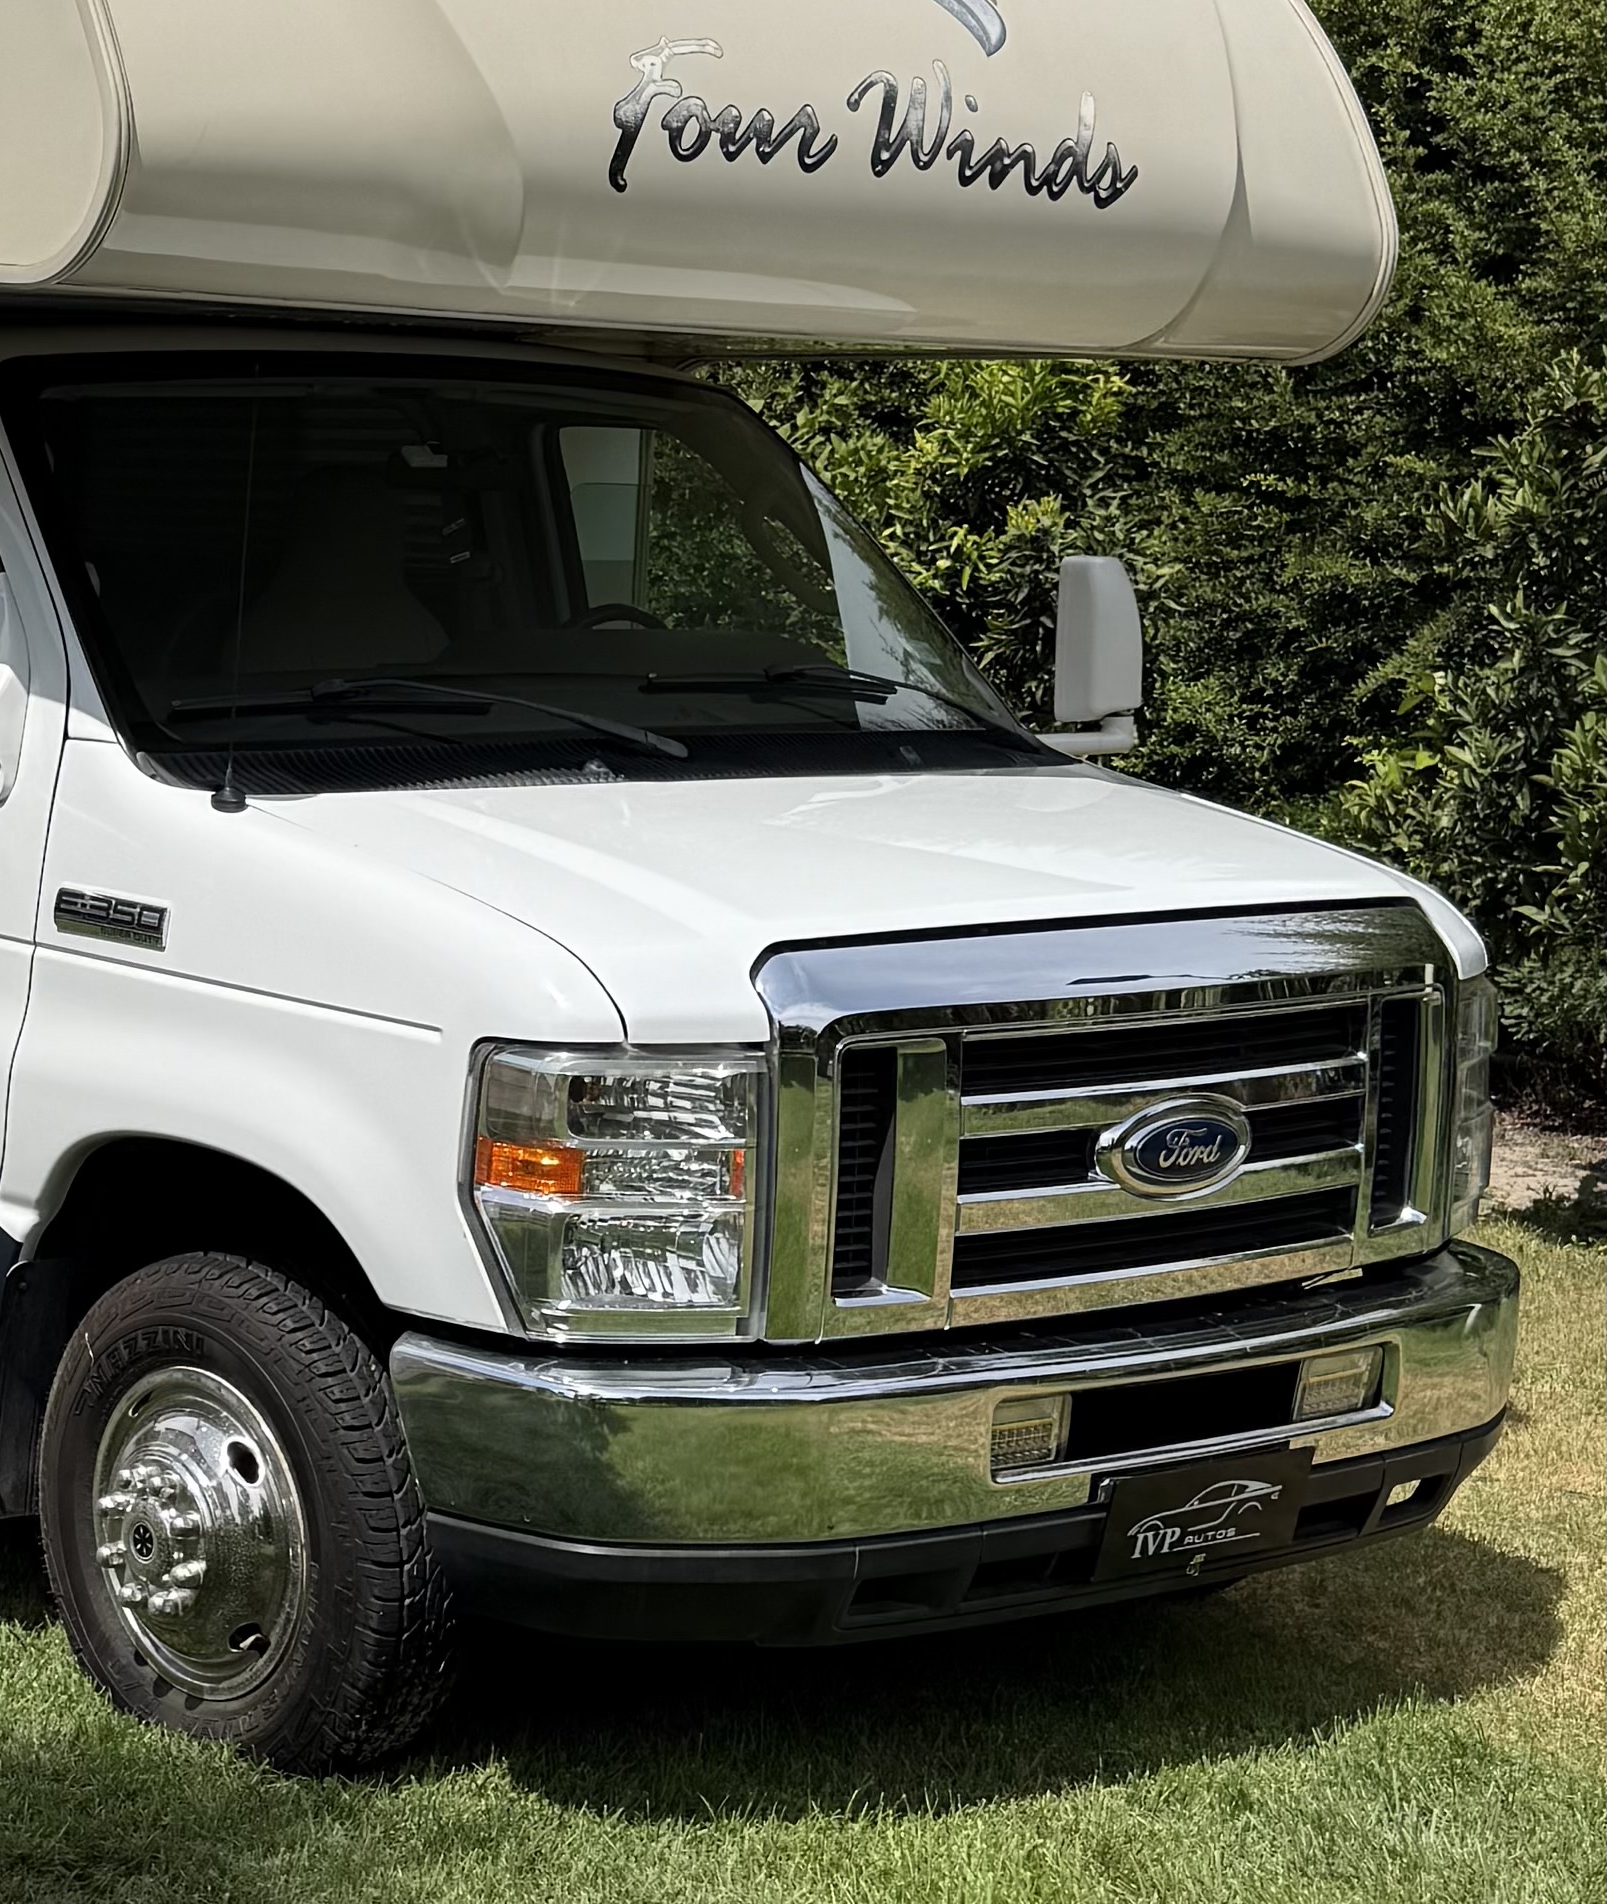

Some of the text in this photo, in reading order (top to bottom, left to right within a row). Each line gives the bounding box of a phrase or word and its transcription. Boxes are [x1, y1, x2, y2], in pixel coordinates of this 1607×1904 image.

[608, 35, 1139, 210] Four Winds
[1158, 1127, 1223, 1169] Ford
[1130, 1526, 1238, 1559] IVP AUTOS
